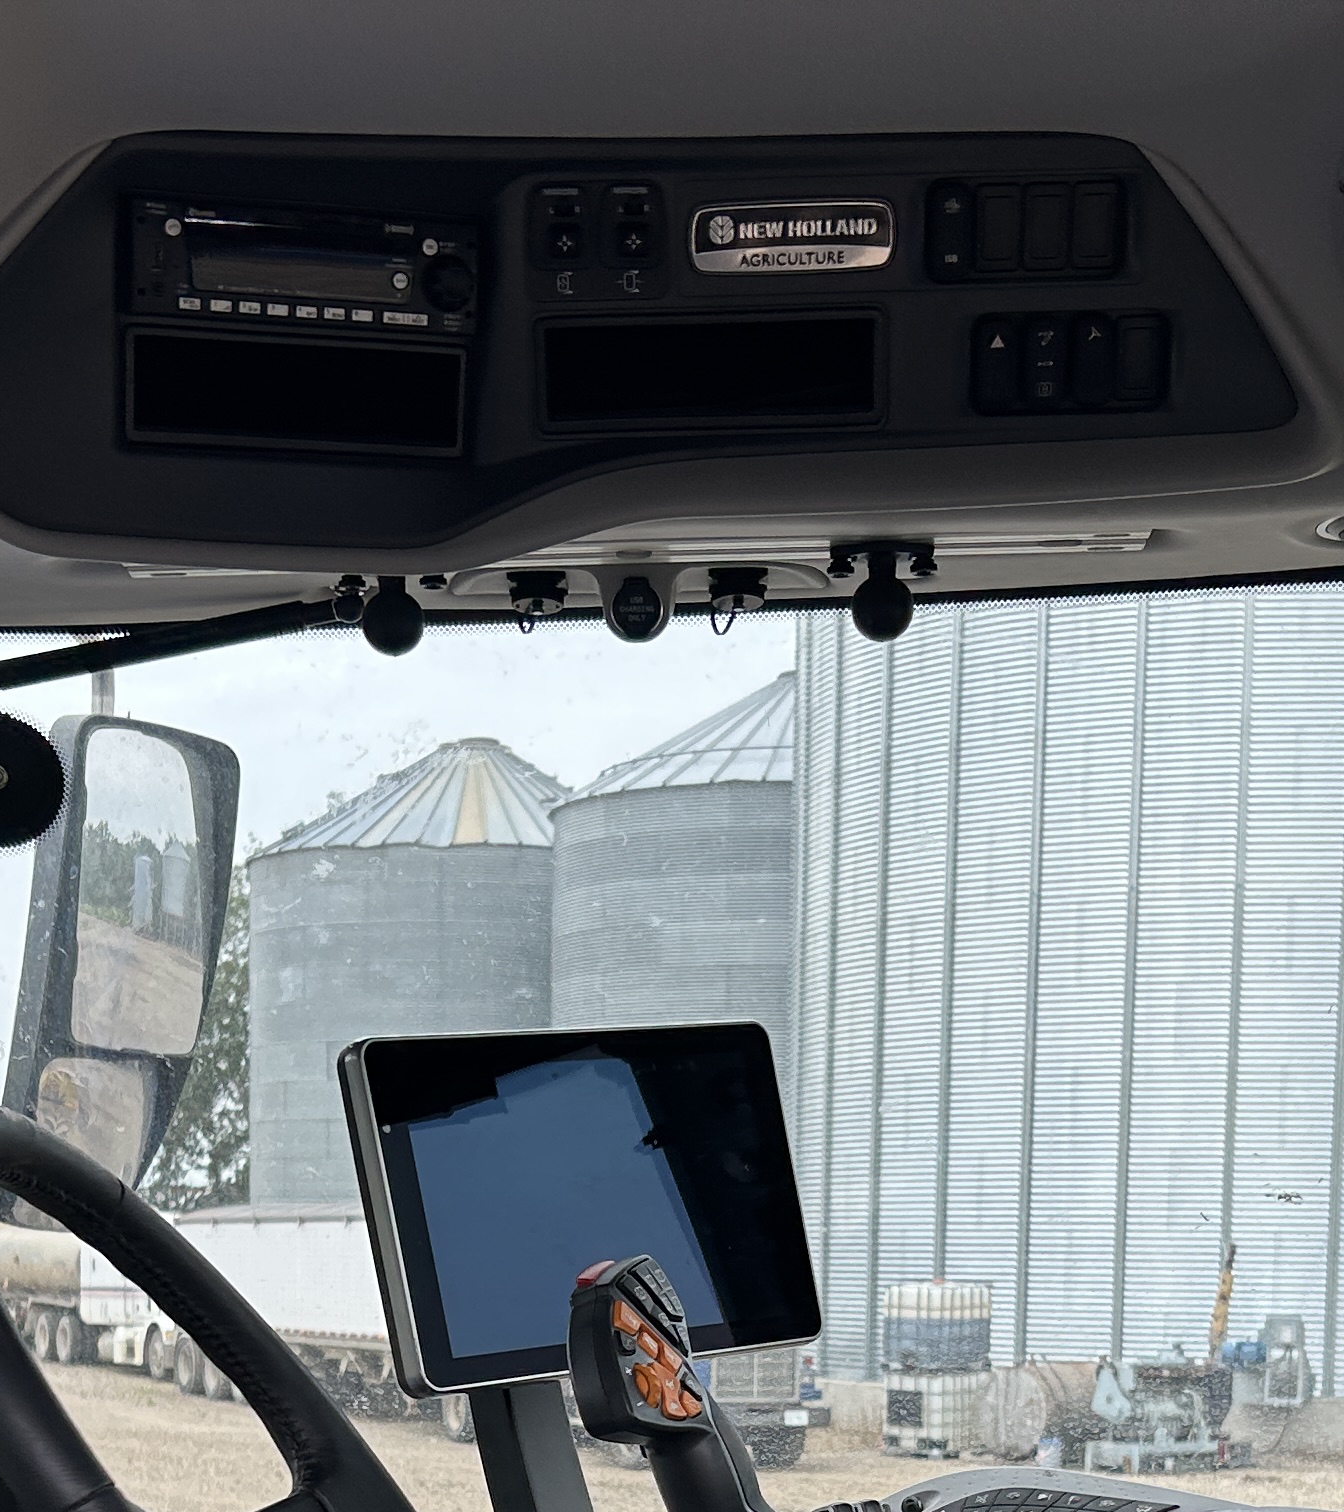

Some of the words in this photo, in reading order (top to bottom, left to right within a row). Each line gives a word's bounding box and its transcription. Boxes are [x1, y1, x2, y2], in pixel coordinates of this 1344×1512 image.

[738, 220, 784, 239] NEW
[787, 218, 878, 238] HOLLAND
[739, 250, 846, 268] AGRICULTURE
